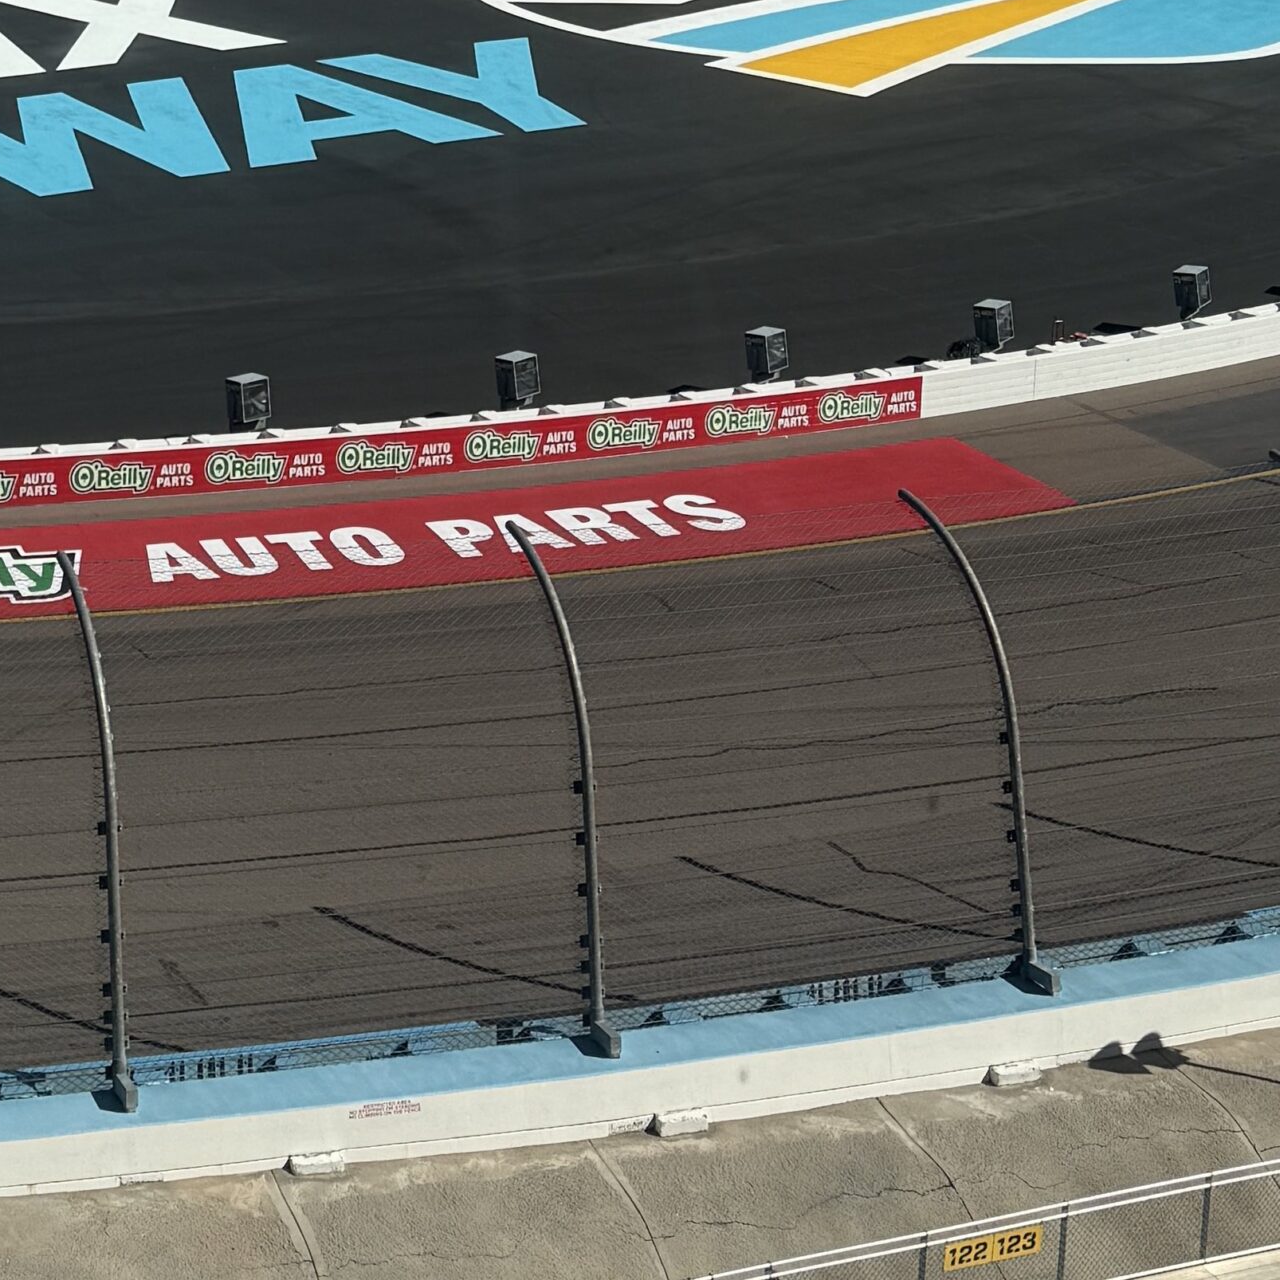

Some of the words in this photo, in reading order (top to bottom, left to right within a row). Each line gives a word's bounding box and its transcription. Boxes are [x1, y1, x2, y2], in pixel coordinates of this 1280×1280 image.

[890, 391, 916, 403] AUTO
[781, 405, 807, 417] AUTO
[822, 394, 884, 421] O'Reilly
[887, 401, 918, 414] PARTS
[666, 418, 693, 430] AUTO
[708, 407, 774, 435] O'Reilly
[778, 415, 809, 428] PARTS
[546, 431, 575, 443] AUTO
[589, 419, 659, 448] O'Reilly
[662, 429, 696, 442] PARTS
[422, 443, 451, 455] AUTO
[467, 431, 539, 459] O'Reilly
[543, 442, 577, 455] PARTS
[293, 453, 323, 466] AUTO
[339, 442, 414, 472] O'Reilly
[418, 453, 454, 467] PARTS
[160, 463, 191, 475] AUTO
[207, 452, 285, 483] O'Reilly
[289, 465, 326, 478] PARTS
[23, 473, 55, 485] AUTO
[72, 461, 152, 492] O'Reilly
[156, 474, 194, 488] PARTS
[19, 484, 58, 497] PARTS
[145, 526, 406, 583] AUTO
[424, 494, 747, 558] PARTS
[997, 1231, 1037, 1256] 123
[948, 1241, 989, 1267] 122
